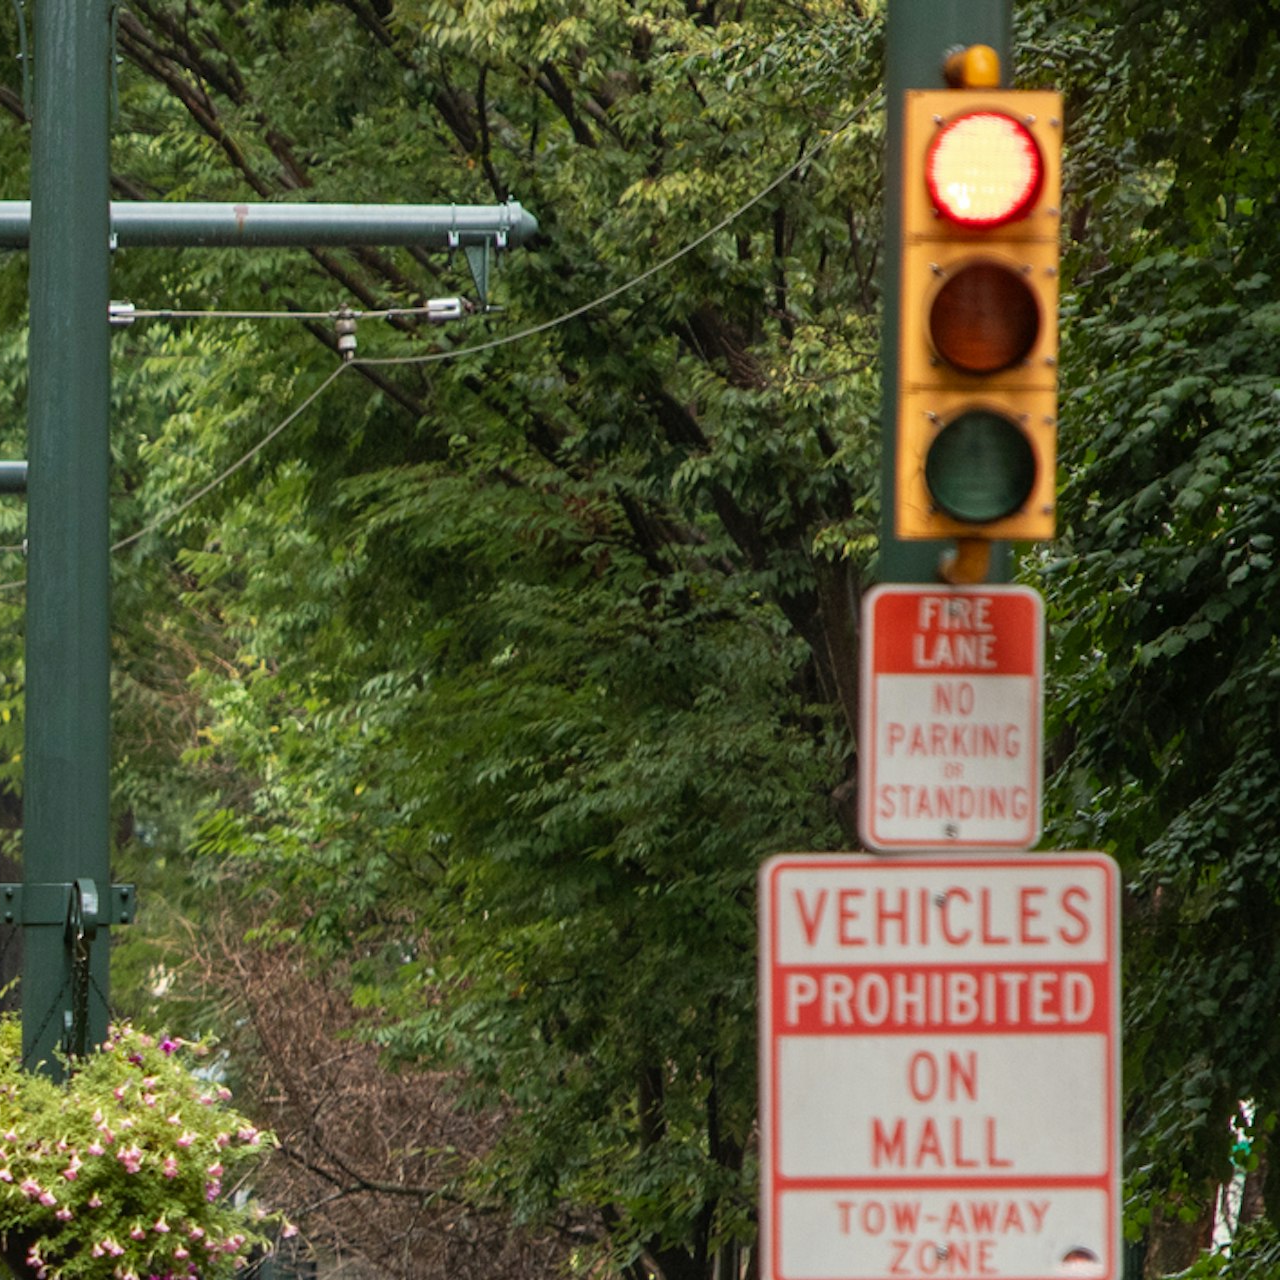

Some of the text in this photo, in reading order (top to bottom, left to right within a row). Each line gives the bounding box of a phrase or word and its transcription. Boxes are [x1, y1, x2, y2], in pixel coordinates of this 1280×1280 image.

[919, 597, 993, 631] FIRE
[913, 634, 997, 668] LANE
[932, 682, 974, 716] NO
[886, 722, 1021, 758] PARKING
[880, 784, 1028, 820] STANDING
[793, 886, 1091, 947] VEHICLES
[786, 972, 1095, 1026] PROHIBITED
[908, 1050, 978, 1102] ON
[871, 1117, 1014, 1168] MALL
[836, 1201, 1051, 1235] TOW-AWAY
[890, 1241, 999, 1275] ZONE
